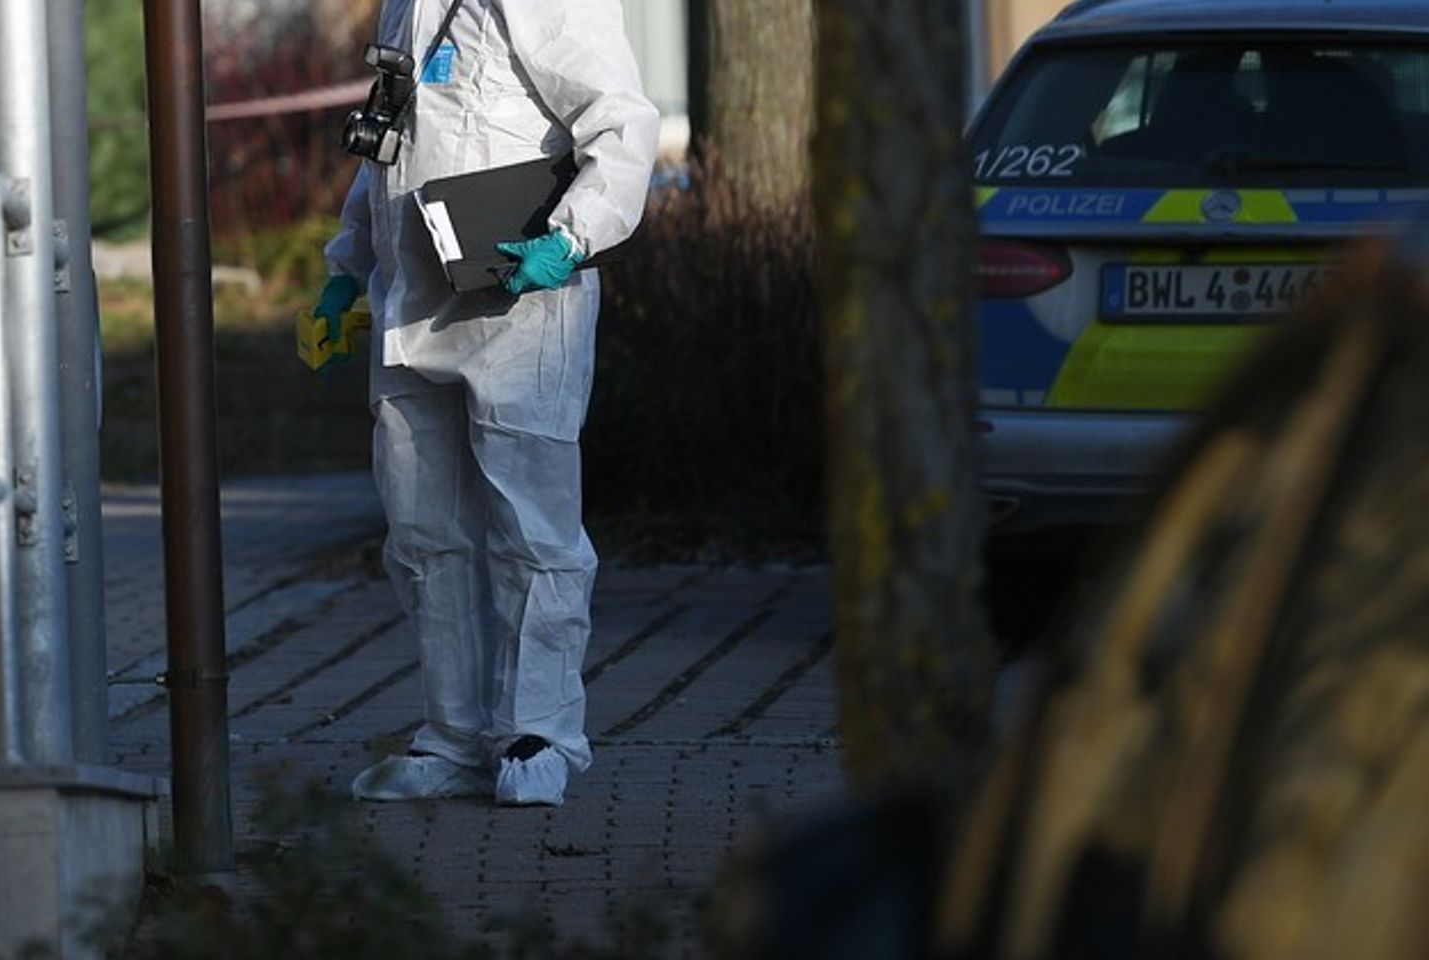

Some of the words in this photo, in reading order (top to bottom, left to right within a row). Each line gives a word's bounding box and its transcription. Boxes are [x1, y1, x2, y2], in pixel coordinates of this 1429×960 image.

[974, 144, 1081, 178] 1/262
[1007, 194, 1124, 215] POLIZEI
[1128, 270, 1195, 309] BWL
[1206, 270, 1225, 308] 4
